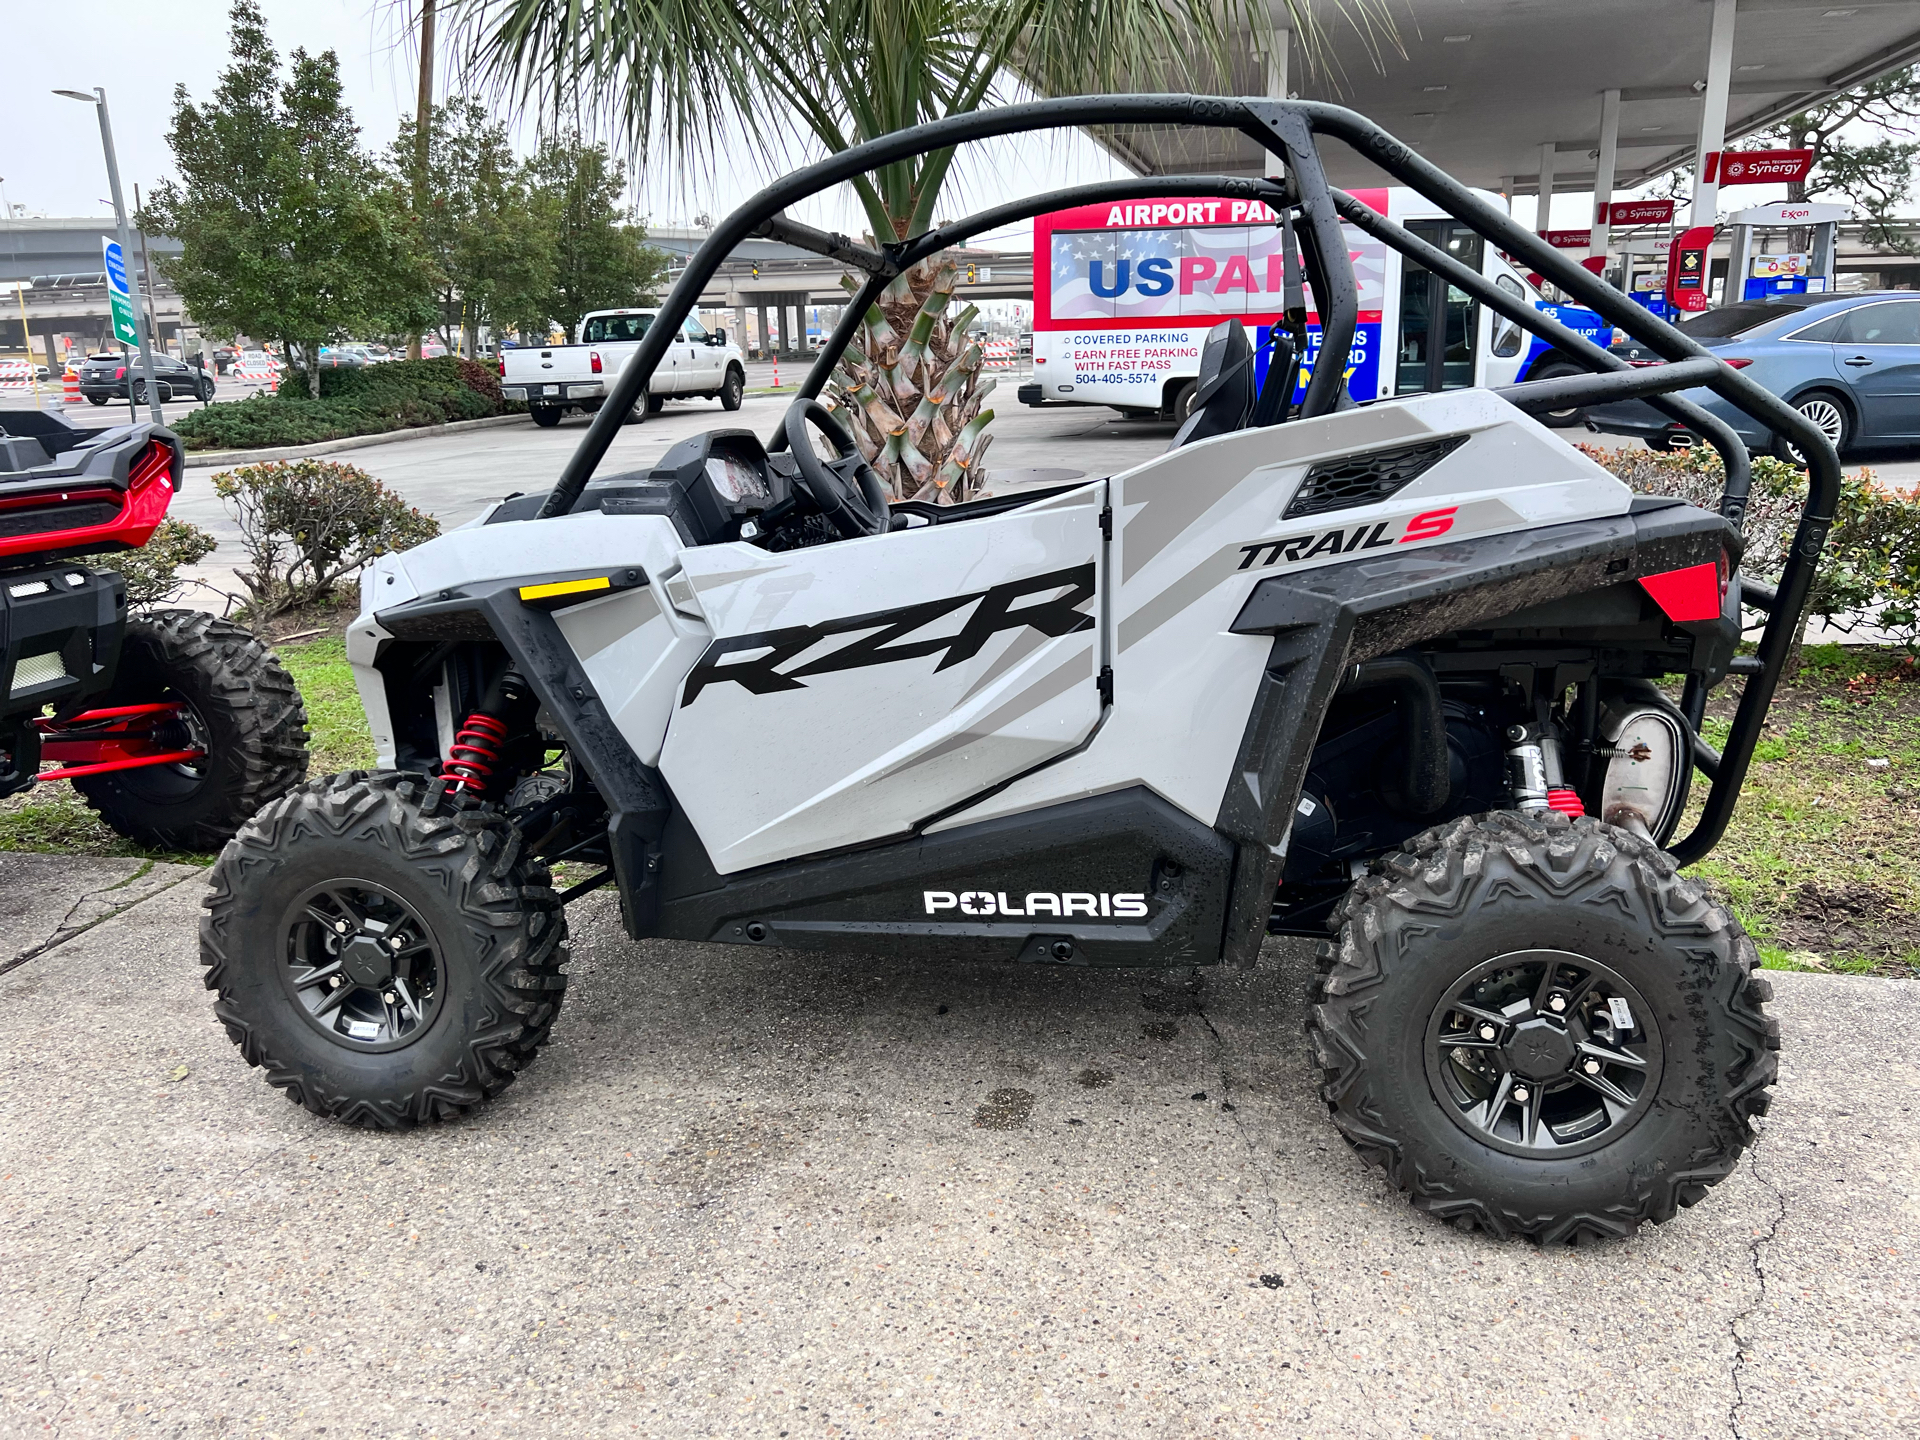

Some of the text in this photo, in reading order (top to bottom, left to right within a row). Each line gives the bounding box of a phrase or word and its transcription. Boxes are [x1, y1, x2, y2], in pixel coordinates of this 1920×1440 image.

[1748, 163, 1801, 176] Synergy
[1106, 202, 1221, 226] AIRPORT
[1629, 209, 1668, 219] Synergy
[1781, 209, 1809, 220] Exxon
[1654, 241, 1670, 249] Exxo
[1580, 328, 1598, 336] LOT
[1074, 333, 1189, 345] COVERED PARKING
[1074, 347, 1198, 360] EARN FREE PARKING
[1075, 360, 1171, 371] WITH FAST PASS
[1075, 373, 1157, 384] 504-405-5574
[1237, 506, 1459, 570] TRAIL S
[680, 562, 1096, 709] RZR
[923, 891, 1149, 917] POLARIS
